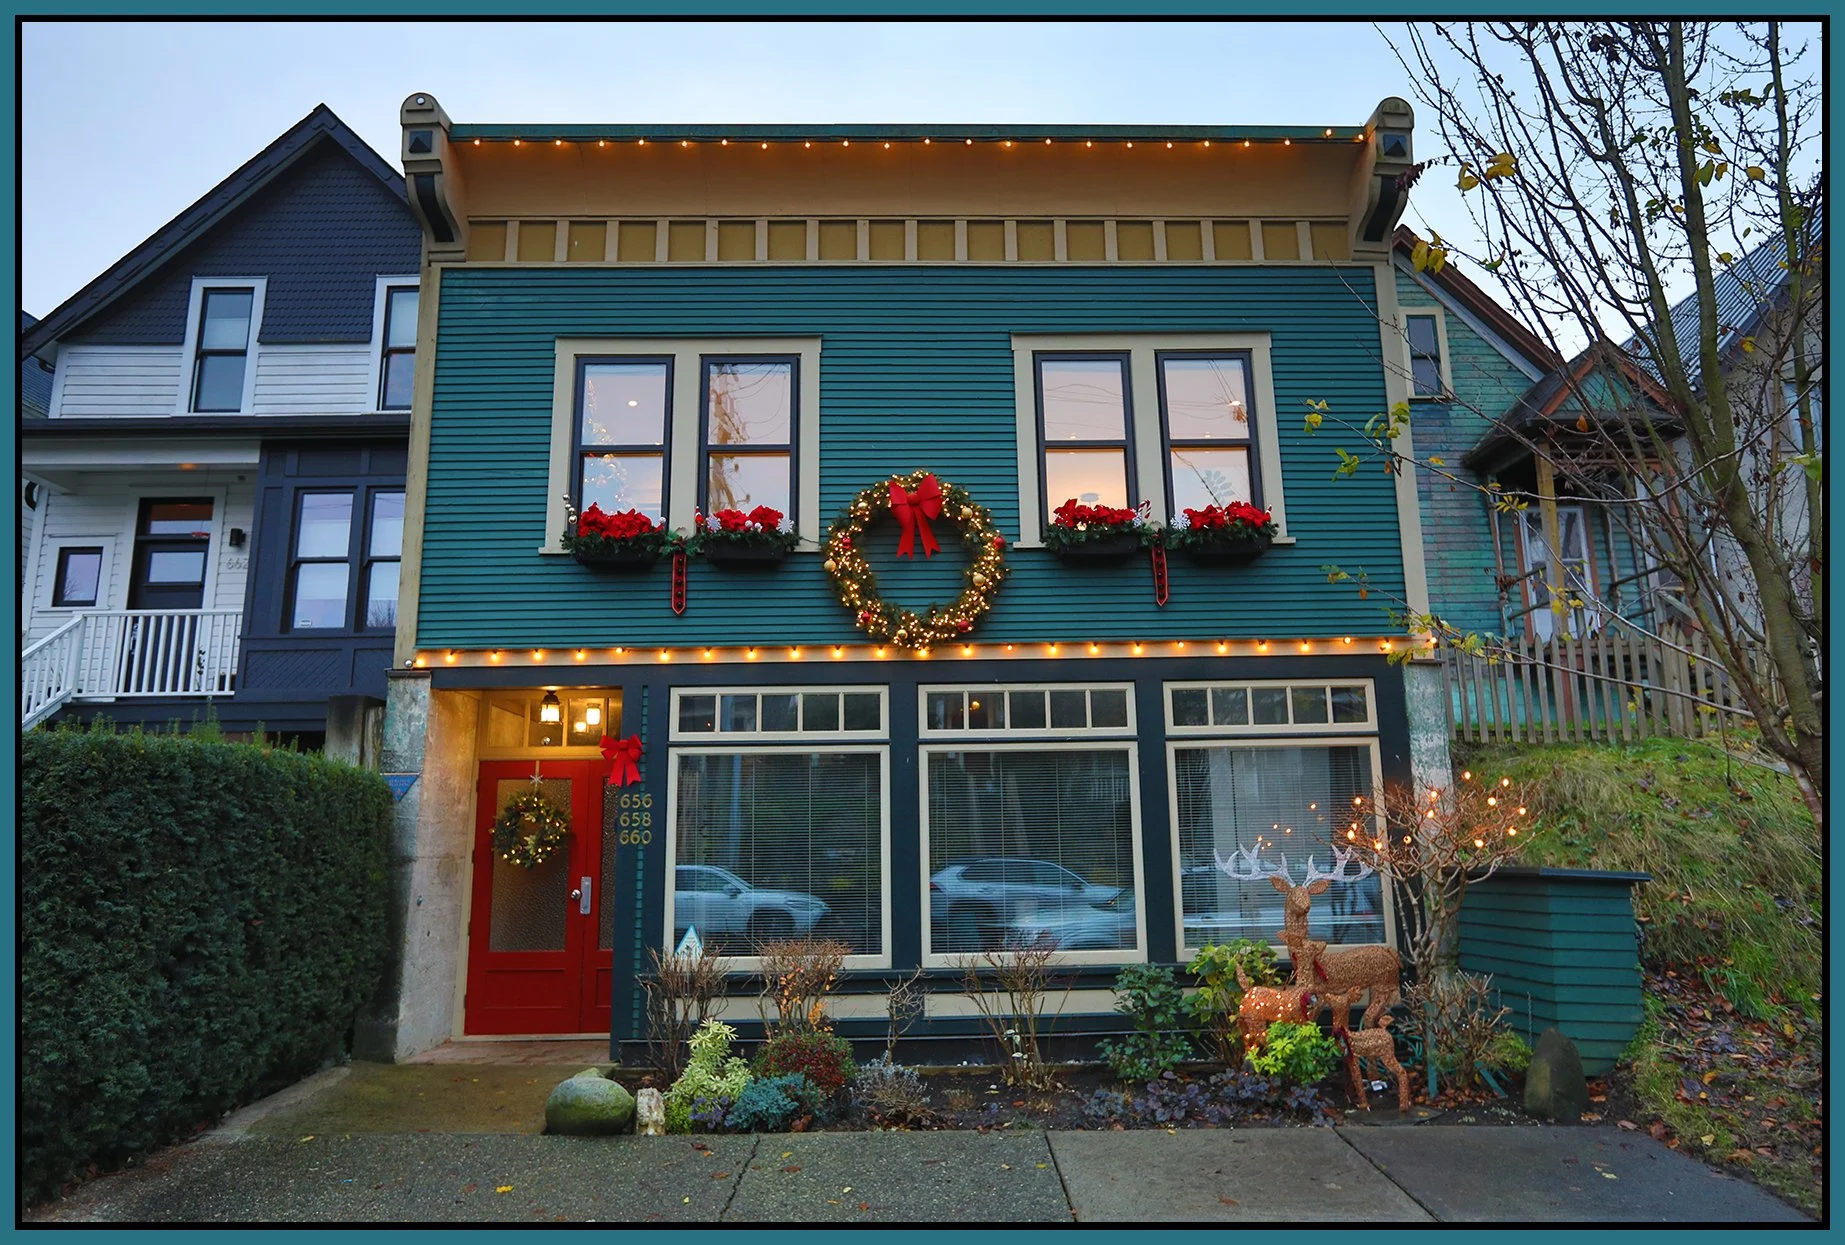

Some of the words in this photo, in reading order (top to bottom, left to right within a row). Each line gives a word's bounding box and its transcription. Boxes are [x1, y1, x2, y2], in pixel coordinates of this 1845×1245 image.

[226, 558, 248, 570] 662
[620, 793, 653, 809] 656
[620, 811, 652, 827] 658
[619, 829, 652, 845] 660
